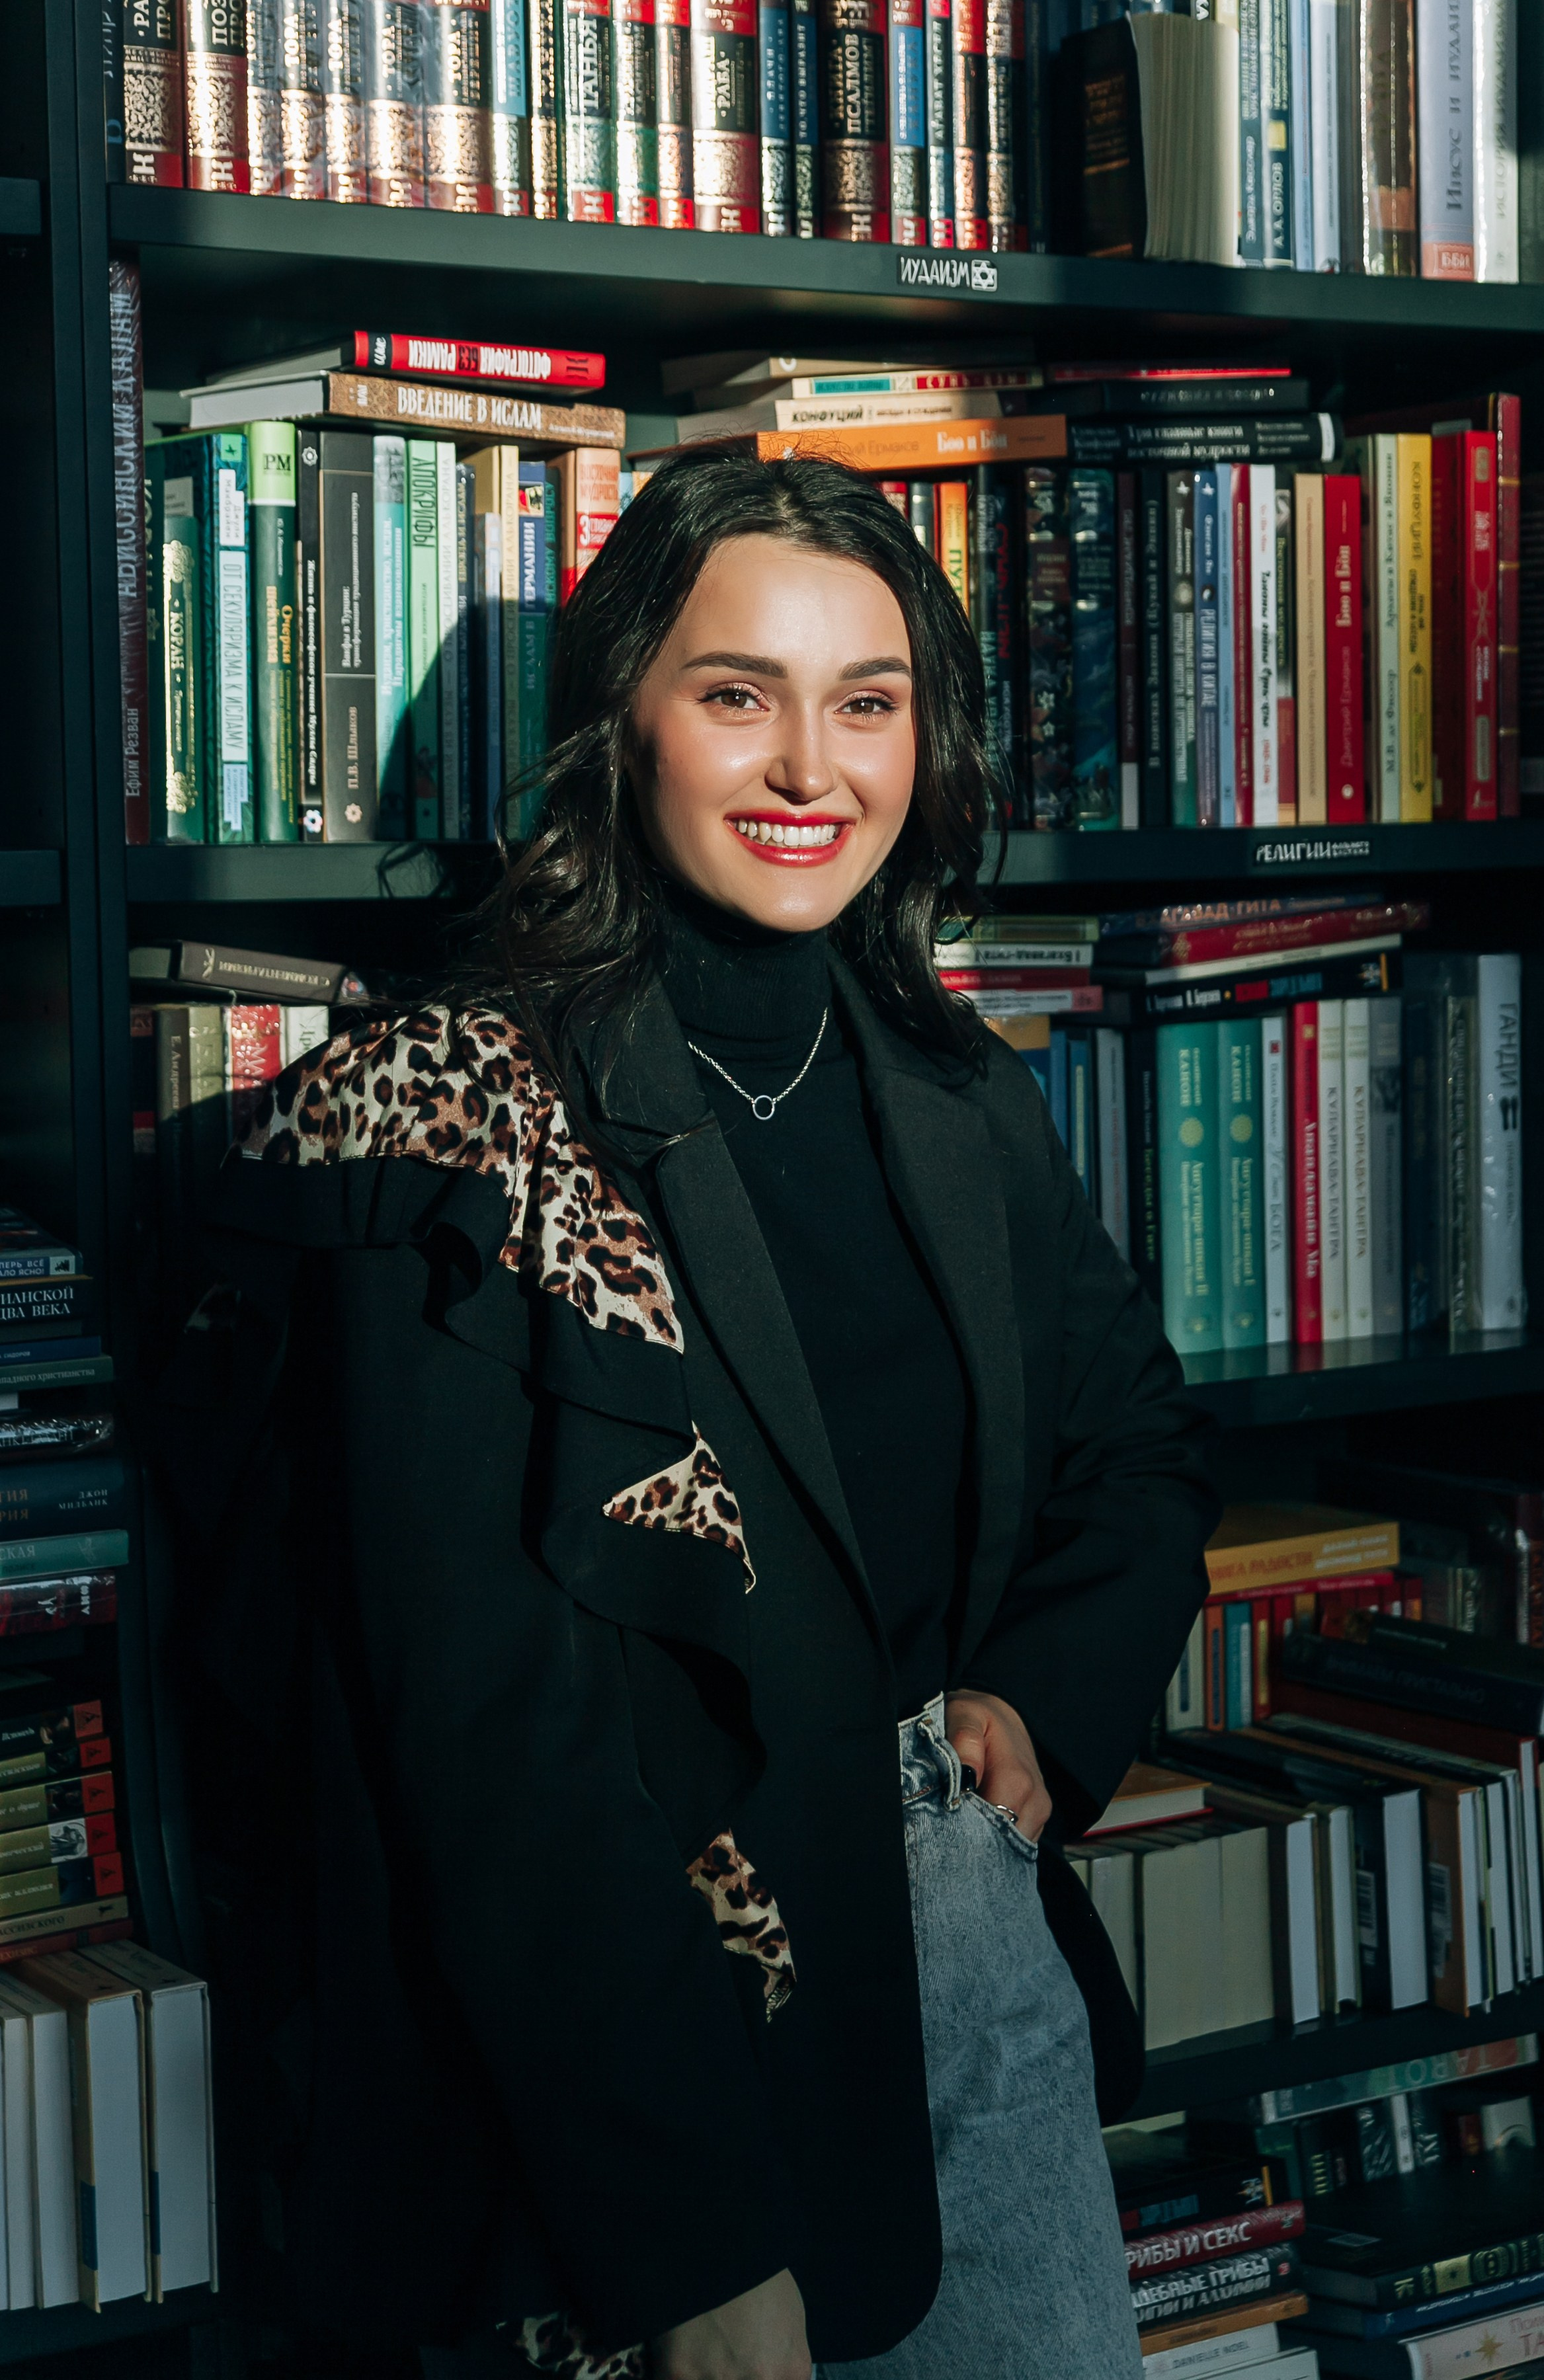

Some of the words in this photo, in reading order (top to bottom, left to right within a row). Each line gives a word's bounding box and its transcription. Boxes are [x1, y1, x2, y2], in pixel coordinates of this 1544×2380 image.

[283, 14, 300, 67] ТОРА
[327, 19, 344, 71] ТОРА
[381, 25, 396, 77] ТОРА
[447, 30, 463, 83] ТОРА
[716, 58, 731, 109] РАБА
[845, 34, 862, 134] ПСАЛМОВ
[1272, 162, 1285, 216] ОРЛОВ
[900, 257, 970, 288] ИУДАИЗМ
[408, 338, 457, 372] РАМКИ
[479, 346, 552, 381] ФОТОГРАФИЯ
[397, 386, 473, 424] ВВЕДЕНИЕ
[477, 398, 489, 424] В
[491, 399, 543, 432] ИСЛАМ
[791, 403, 864, 424] КОНФУЦИЙ
[412, 457, 436, 549] АПОКРИФЫ
[579, 514, 590, 547] 3
[222, 563, 243, 580] ОТ
[522, 521, 536, 608] ГЕРМАНИИ
[170, 610, 185, 670] КОРАН
[222, 584, 245, 678] СЕКУЛЯРИЗМА
[280, 604, 294, 664] Очерки
[341, 634, 352, 668] Вакфы
[391, 620, 405, 688] Парадигмы
[1200, 608, 1215, 658] РЕЛИГИЯ
[224, 682, 245, 691] К
[1201, 674, 1216, 708] КИТАЕ
[124, 707, 140, 756] Резван
[223, 695, 246, 750] ИСЛАМУ
[346, 706, 358, 760] Шлыков
[125, 760, 142, 799] Ефим
[1256, 841, 1332, 863] РЕЛИГИИ
[1495, 1002, 1519, 1090] ГАНДИ
[1179, 1049, 1191, 1106] КАНОН
[1231, 1046, 1242, 1103] КАНОН
[19, 1267, 44, 1277] ЯСНО!
[32, 1303, 71, 1318] ВЕКА
[38, 1368, 96, 1383] христианства
[58, 1497, 108, 1510] МИЛБАНК
[79, 1489, 108, 1500] ДЖОН
[1388, 2044, 1492, 2092] TAROT
[1125, 2239, 1181, 2269] РИБЫ
[1184, 2235, 1200, 2256] И
[1203, 2221, 1252, 2250] СЕКС
[1209, 2256, 1270, 2287] ГРИБЫ
[1223, 2341, 1251, 2356] NOEL
